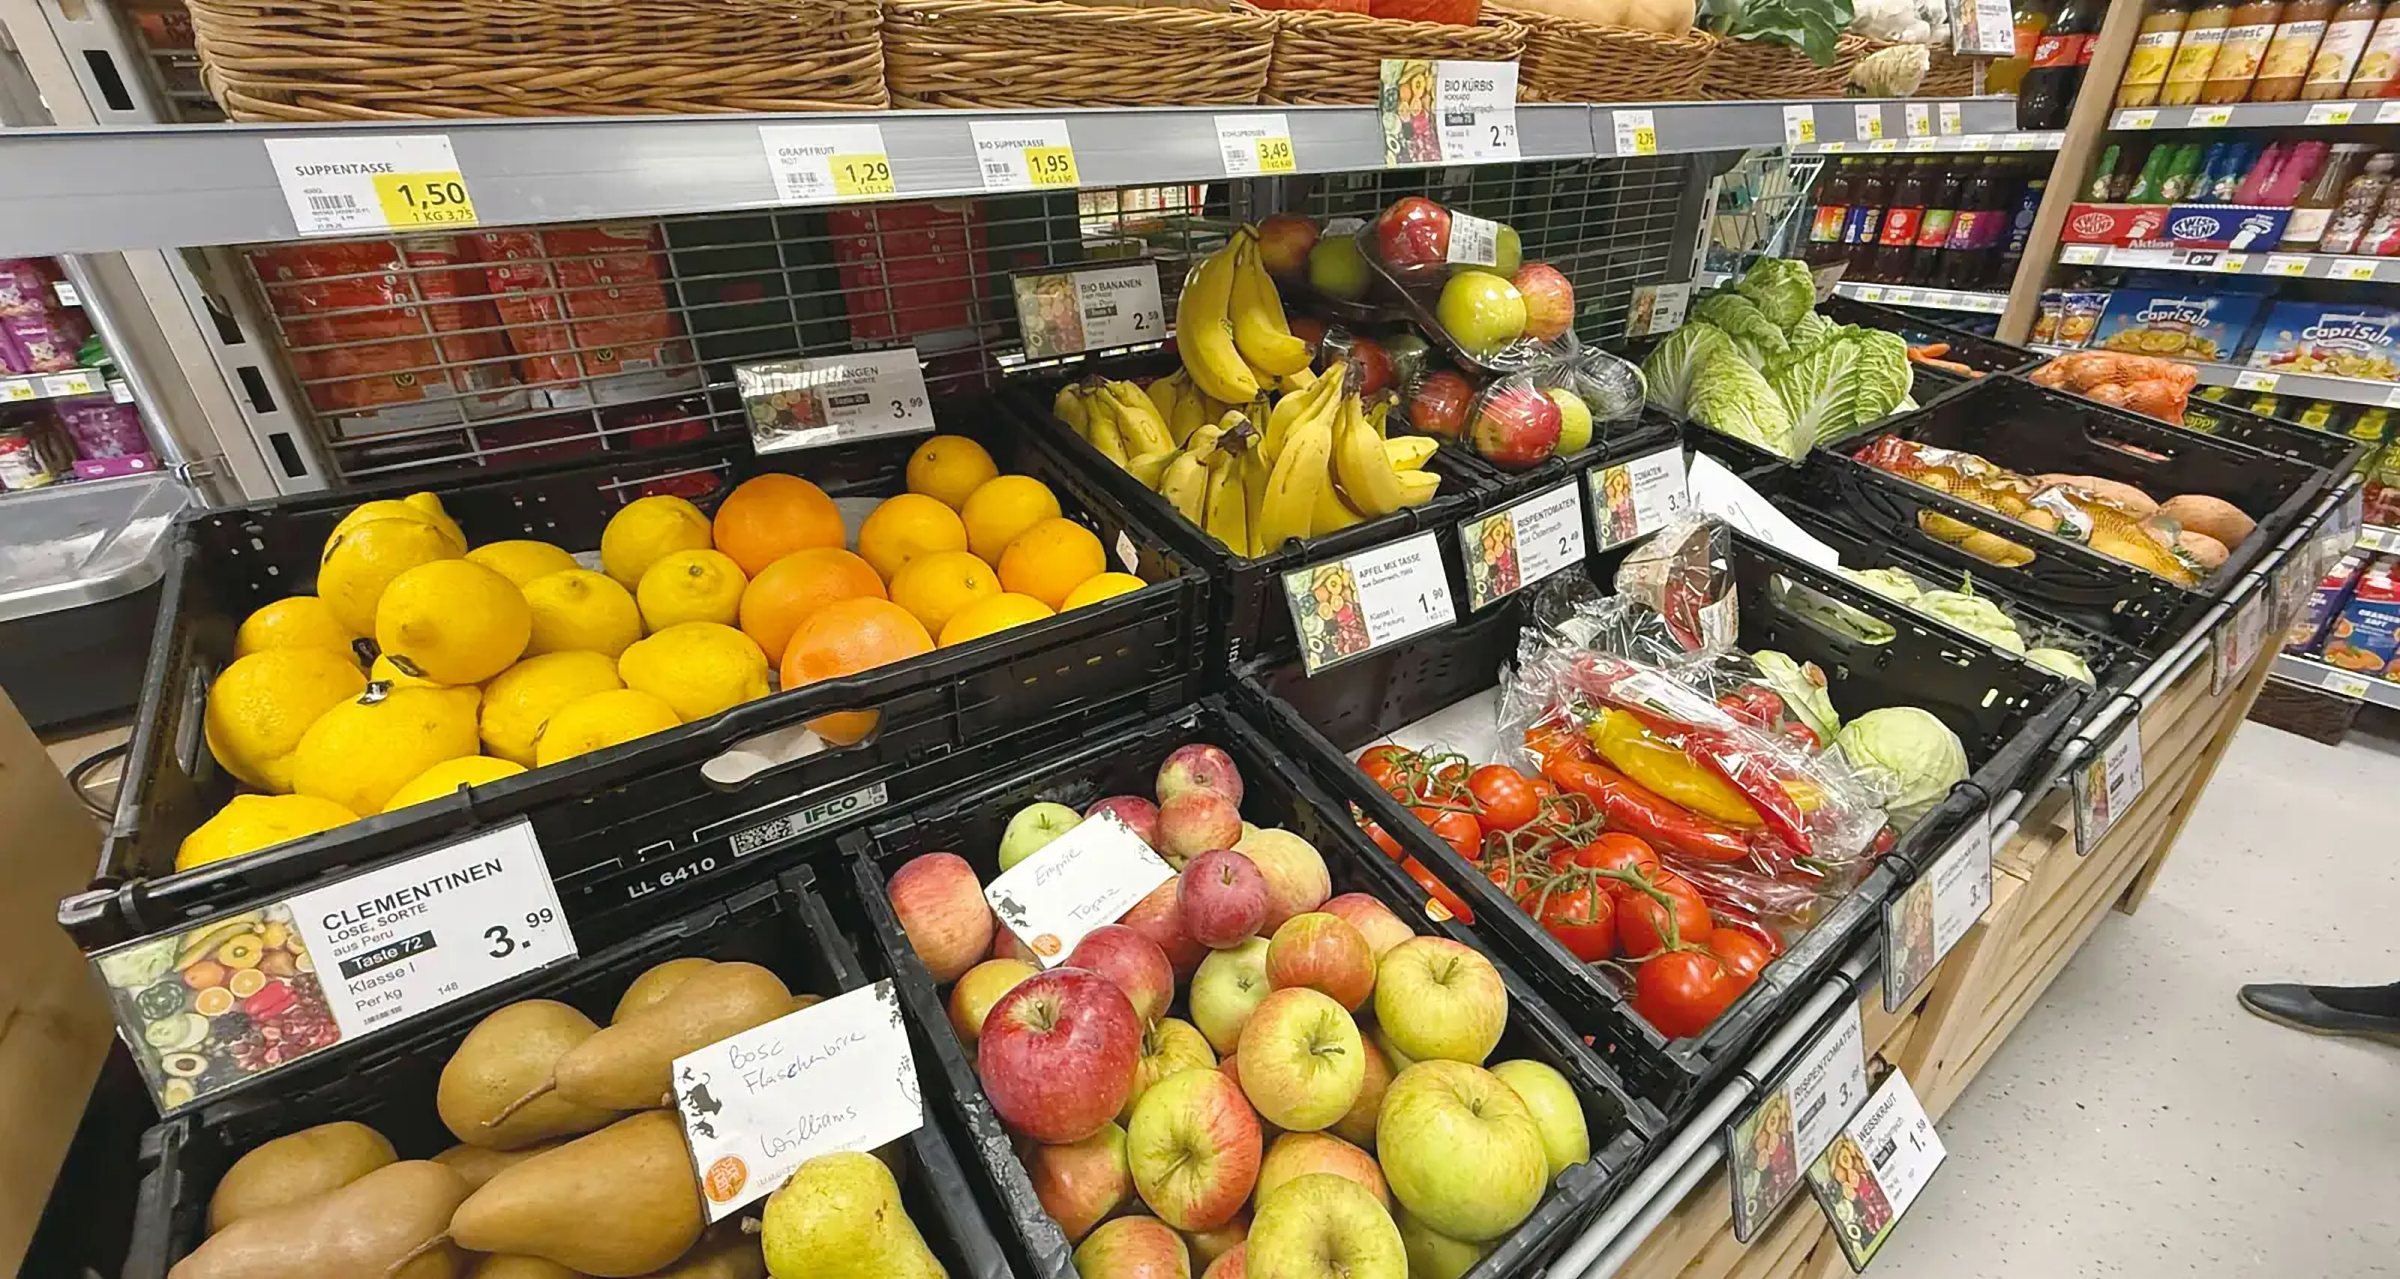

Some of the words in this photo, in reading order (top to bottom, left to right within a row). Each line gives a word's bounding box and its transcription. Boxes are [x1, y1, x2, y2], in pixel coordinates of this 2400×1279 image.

[1444, 80, 1460, 92] BIO
[1462, 77, 1494, 92] KÜRBIS
[778, 146, 835, 157] GRAPEFRUIT
[1260, 142, 1288, 160] 3,49
[296, 162, 394, 176] SUPPENTASSE
[845, 162, 890, 184] 1,29
[1031, 154, 1069, 175] 1,95
[397, 182, 466, 210] 1,50
[412, 212, 420, 222] 1
[424, 210, 443, 222] KG
[448, 208, 474, 222] 3,75
[2128, 238, 2174, 249] Aktion
[1080, 284, 1097, 294] BIO
[1099, 278, 1142, 292] BANANEN
[1133, 310, 1159, 330] 2.59
[890, 396, 923, 418] 3.99
[2185, 416, 2220, 432] appy
[1518, 498, 1576, 527] RISPENTOMATEN
[1359, 565, 1384, 579] APFEL
[1384, 561, 1398, 574] MIX
[1398, 553, 1421, 566] TASSE
[1418, 588, 1444, 614] 1.90
[1370, 610, 1390, 622] Klasse
[805, 796, 858, 824] IFCO
[627, 881, 656, 899] LL
[660, 857, 716, 888] 6410
[322, 858, 504, 931] CLEMENTINEN
[328, 923, 376, 944] LOSE,
[378, 902, 428, 928] SORTE
[482, 907, 554, 958] 3.99
[334, 942, 358, 958] aus
[362, 929, 394, 948] Peru
[351, 946, 398, 970] Taste
[402, 936, 424, 953] 72
[348, 966, 406, 995] Klasse
[410, 962, 416, 974] I
[438, 982, 458, 996] 148
[356, 994, 382, 1012] Per
[384, 988, 403, 1004] kg
[1794, 1020, 1857, 1101] RISPENTOMATEN
[1857, 1092, 1896, 1142] WEISSKRAUT
[760, 1105, 857, 1158] Williams
